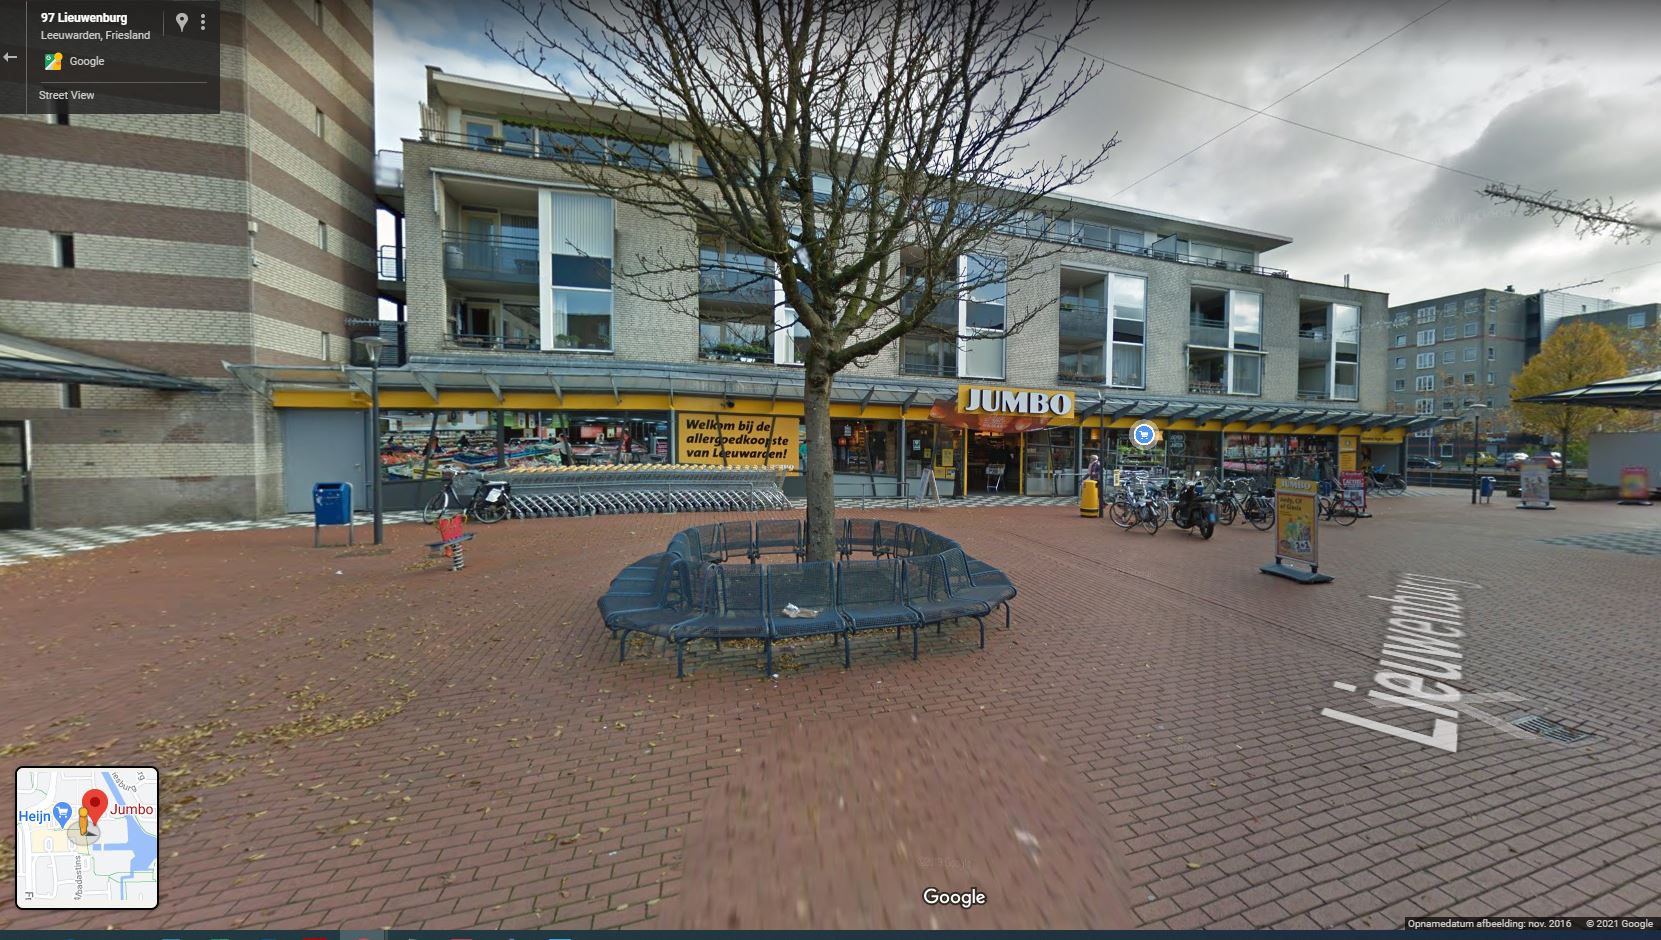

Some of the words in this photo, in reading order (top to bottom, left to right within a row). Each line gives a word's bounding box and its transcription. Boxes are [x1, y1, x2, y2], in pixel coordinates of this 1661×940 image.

[965, 387, 1073, 416] JUMBO
[686, 419, 735, 431] Welkom
[738, 420, 755, 434] bij
[756, 421, 771, 432] de
[686, 433, 789, 448] allergoedkoopste
[687, 449, 709, 458] van
[712, 448, 788, 459] Leeuwarden!
